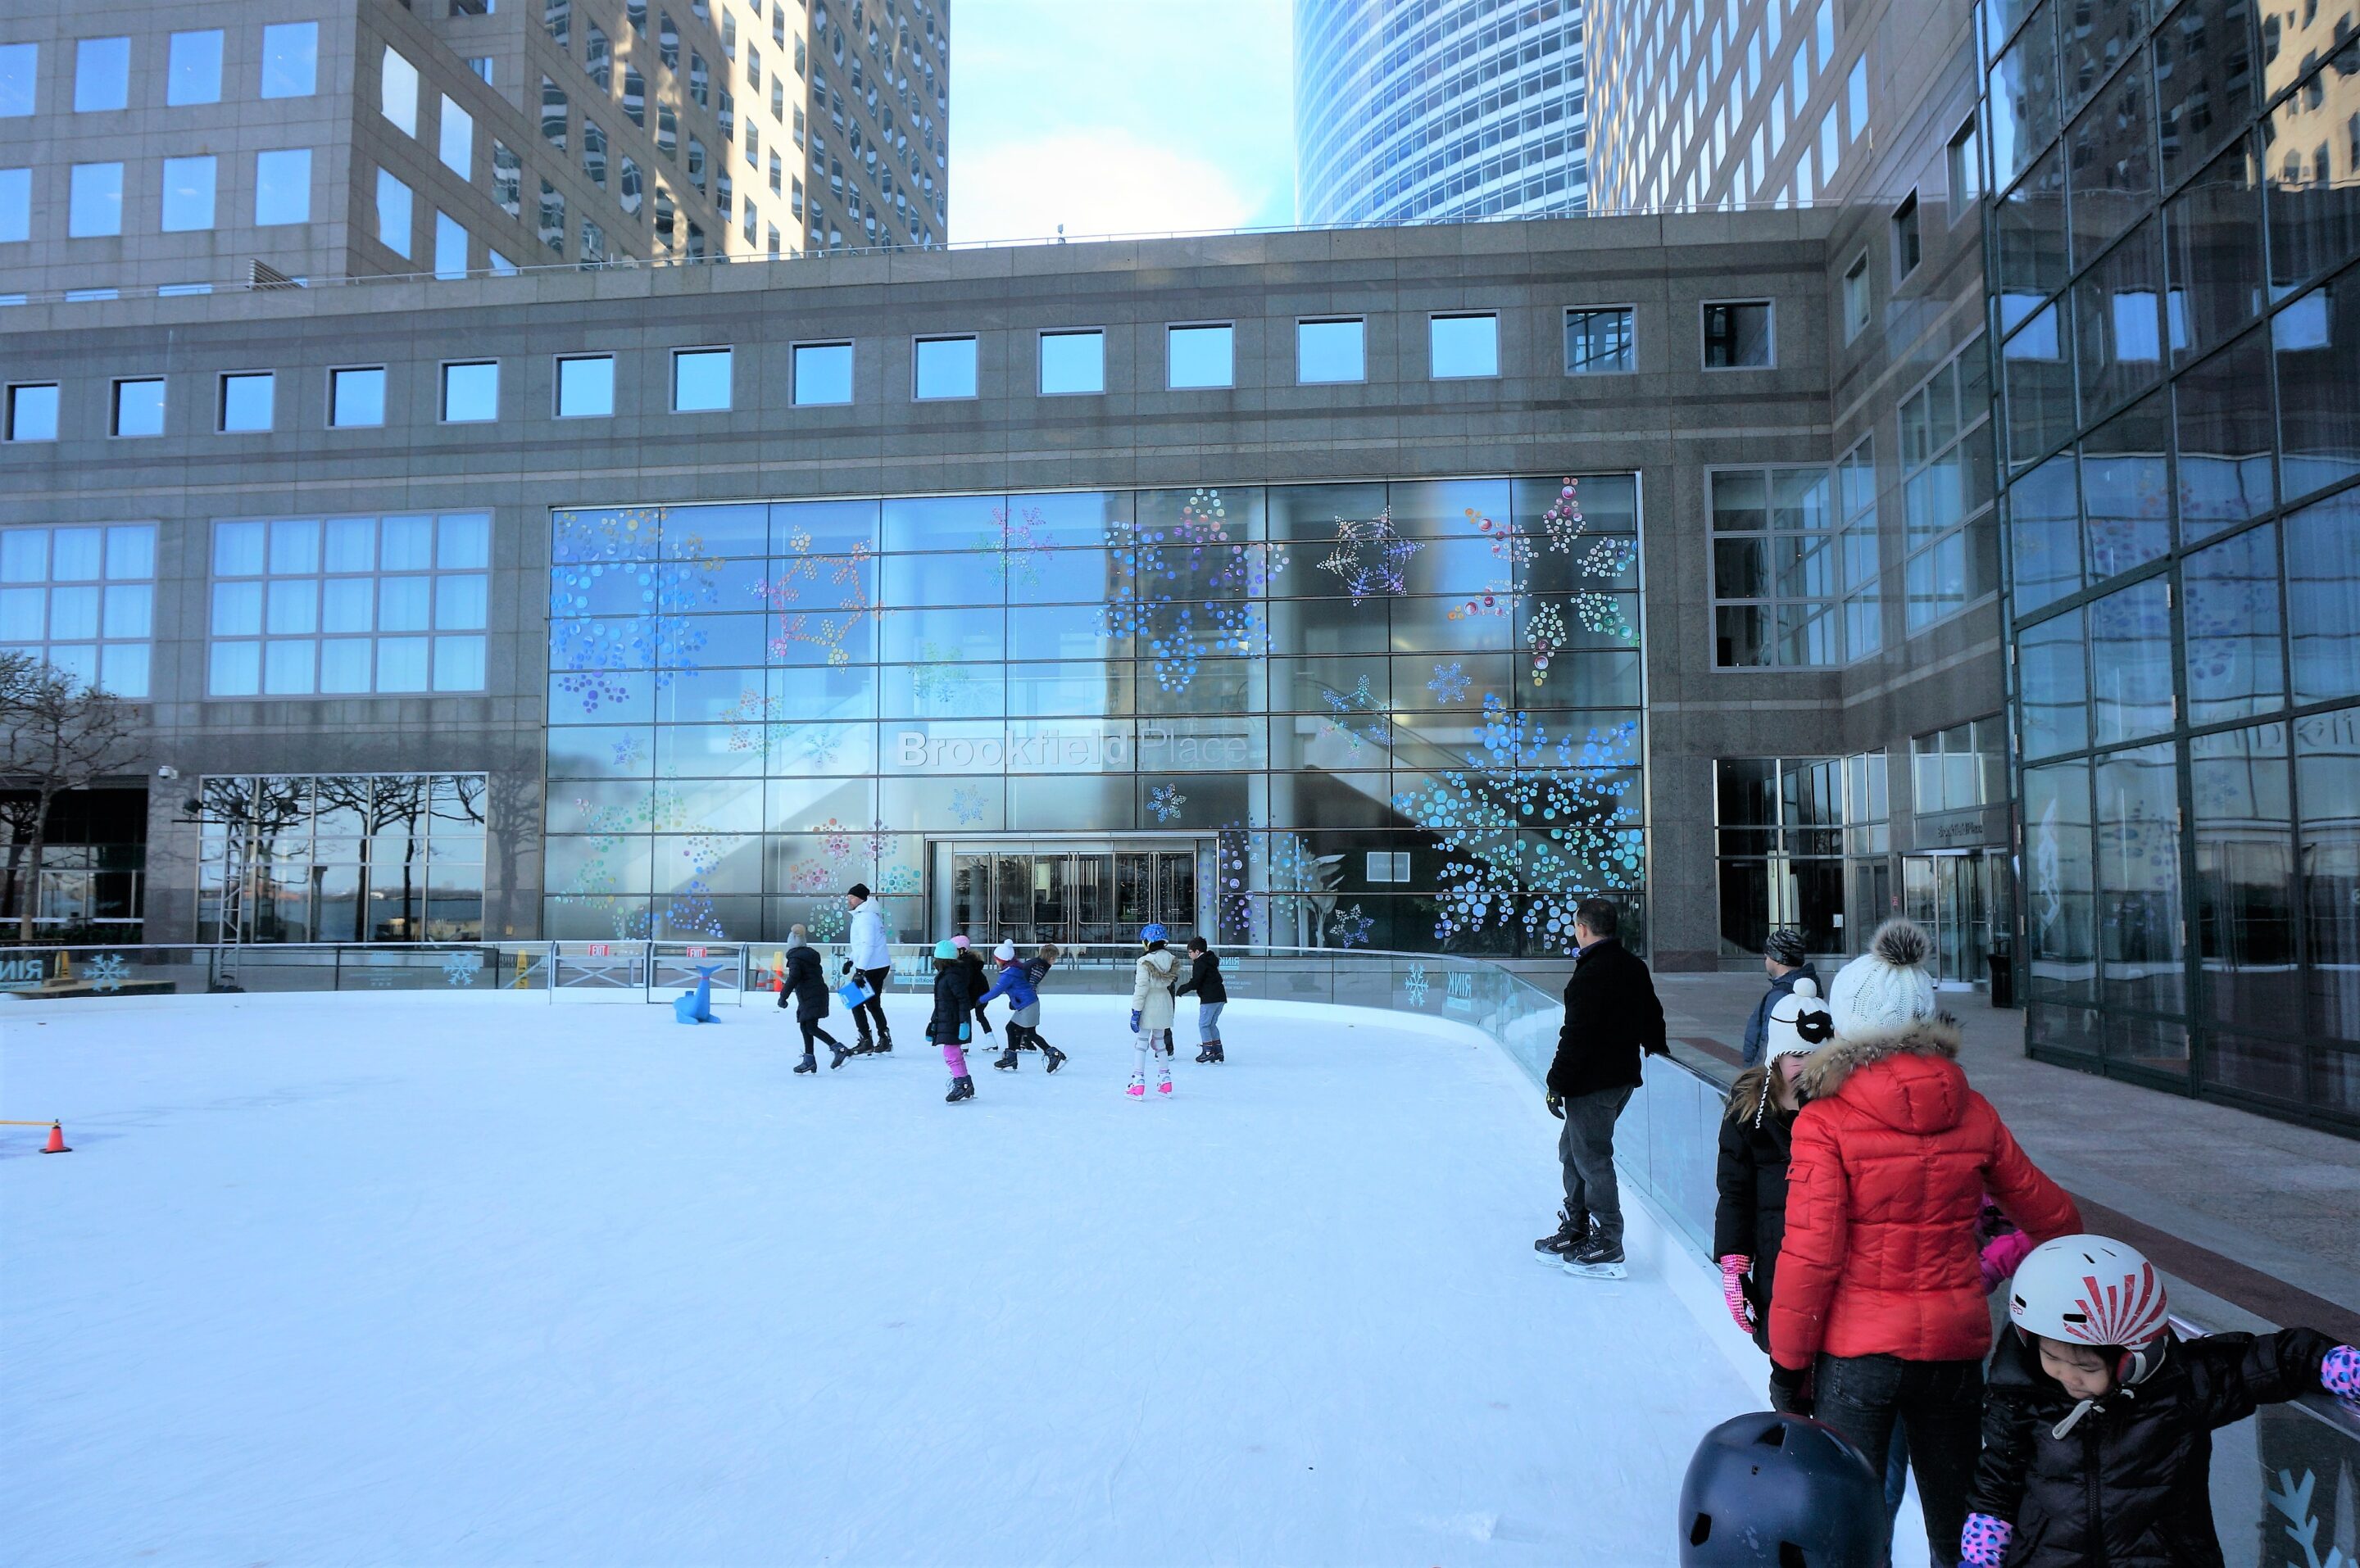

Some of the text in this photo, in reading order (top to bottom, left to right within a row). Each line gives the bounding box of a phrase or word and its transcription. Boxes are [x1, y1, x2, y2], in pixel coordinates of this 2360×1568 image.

[897, 727, 1249, 767] Brookfield Place
[592, 945, 606, 955] EXIT
[690, 948, 703, 957] EXIT
